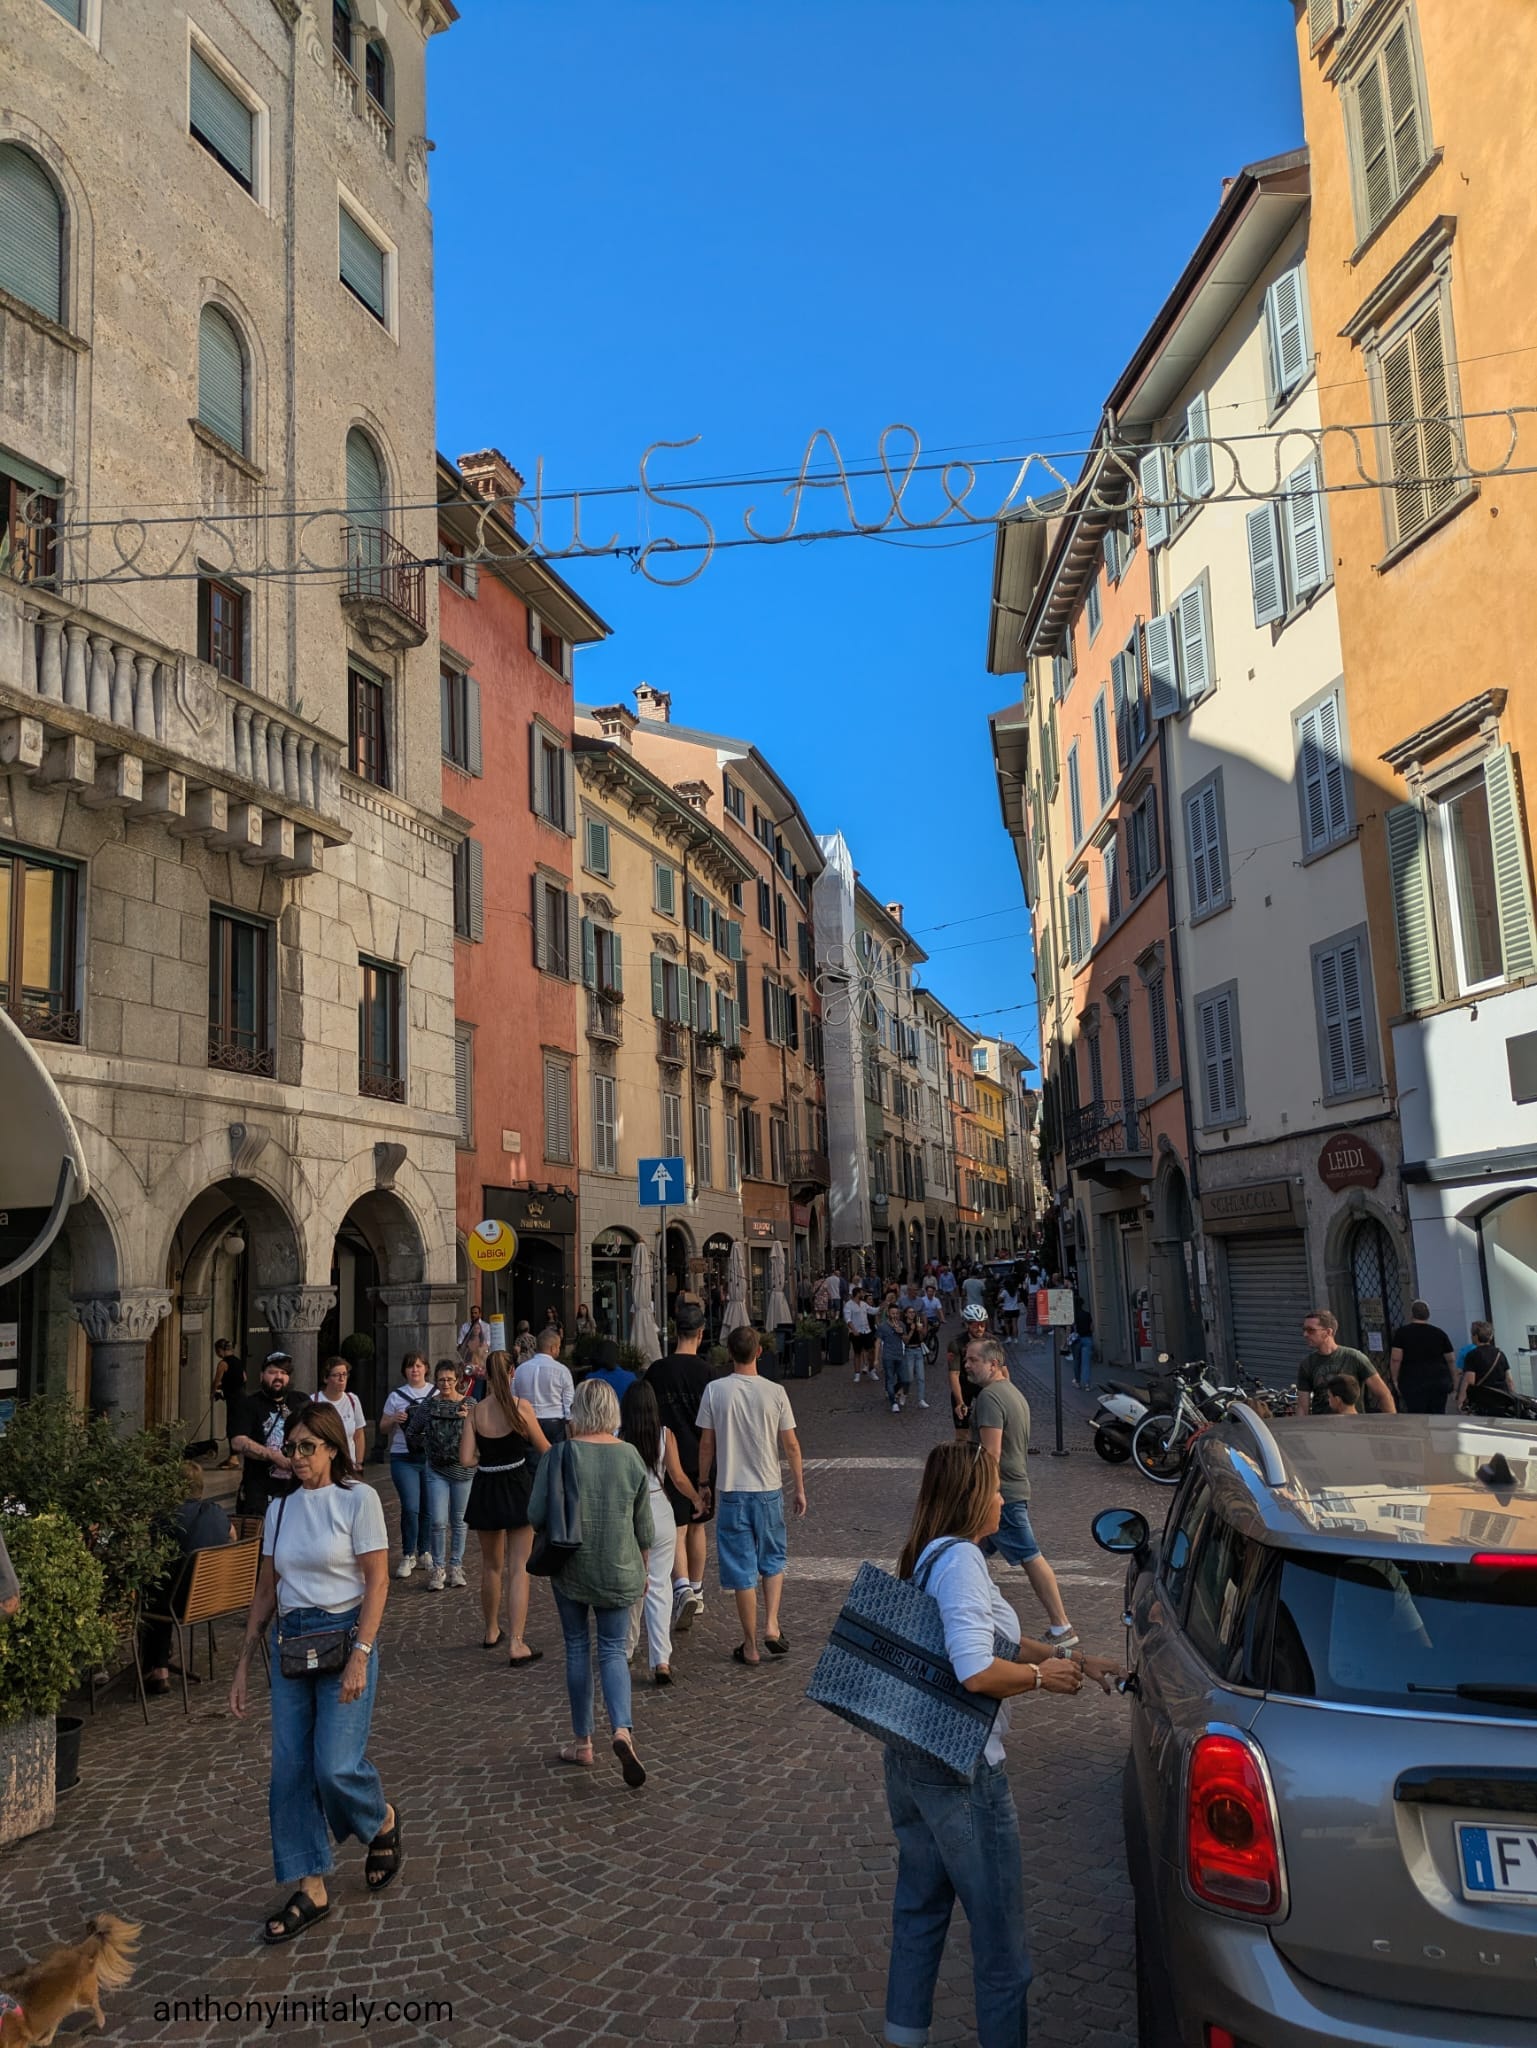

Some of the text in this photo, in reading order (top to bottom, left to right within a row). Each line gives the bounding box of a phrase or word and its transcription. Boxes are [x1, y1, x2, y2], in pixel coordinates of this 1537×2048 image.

[1328, 1148, 1365, 1170] LEIDI
[872, 1638, 958, 1693] CHRISTIAN DIOR
[1371, 1939, 1537, 1968] COU
